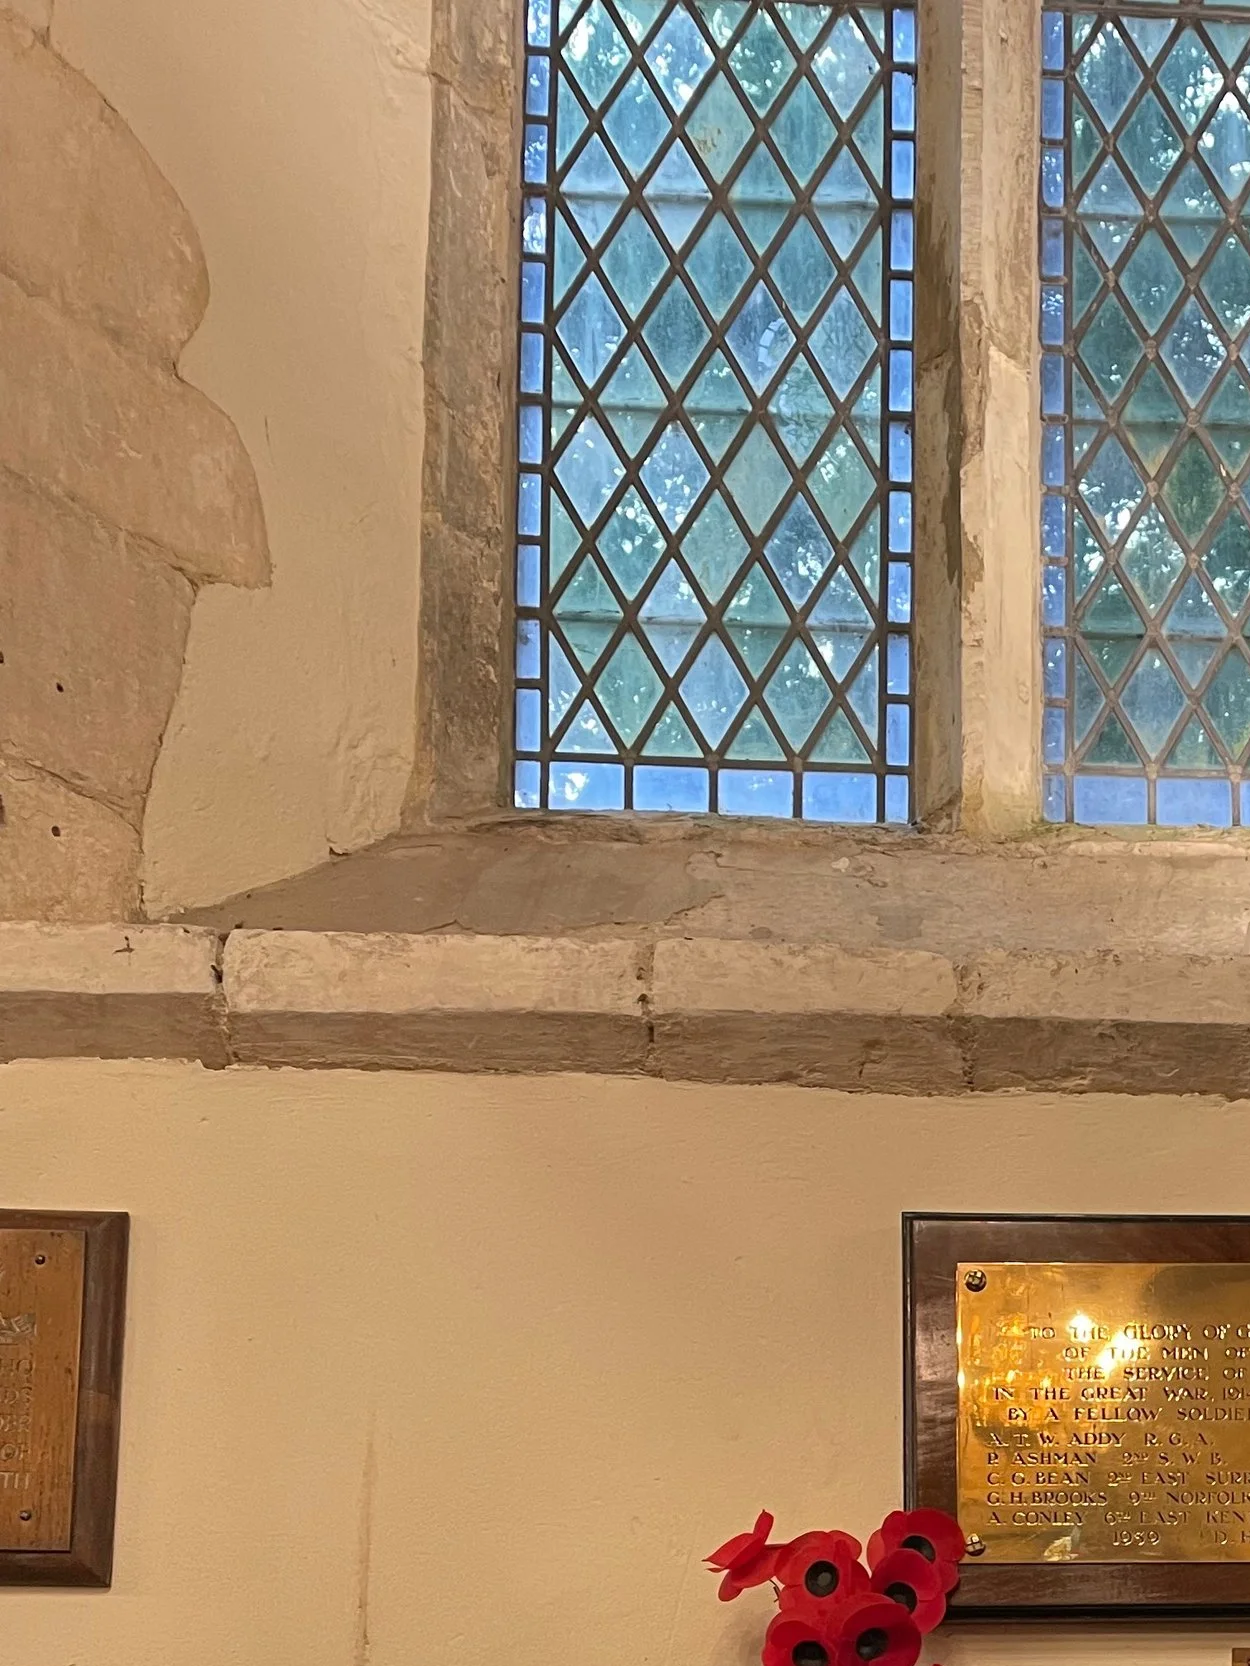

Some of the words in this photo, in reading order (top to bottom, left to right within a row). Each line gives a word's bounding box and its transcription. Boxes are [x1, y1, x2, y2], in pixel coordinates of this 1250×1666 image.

[1030, 1324, 1056, 1340] TO
[1123, 1324, 1193, 1340] GLORY
[1202, 1324, 1230, 1340] OF
[1064, 1346, 1091, 1361] OF
[1107, 1346, 1151, 1361] THE
[1161, 1346, 1209, 1361] MEN
[1225, 1346, 1250, 1361] OF
[1063, 1366, 1106, 1381] THE
[1222, 1366, 1247, 1381] OF
[993, 1386, 1015, 1401] IN
[1028, 1386, 1071, 1401] THE
[1080, 1386, 1148, 1401] GREAT
[1008, 1406, 1032, 1421] BY
[1047, 1406, 1059, 1421] A
[1074, 1406, 1163, 1421] FELLOW
[1066, 1432, 1127, 1447] ADDY
[1011, 1451, 1098, 1467] ASHMAN
[986, 1471, 1006, 1487] C.
[1035, 1471, 1091, 1487] BEAN
[1140, 1471, 1190, 1487] EAST
[1031, 1491, 1108, 1506] BROOKS
[1128, 1491, 1157, 1506] 9TH
[1012, 1511, 1087, 1526] CONLEY
[1139, 1511, 1192, 1526] EAST
